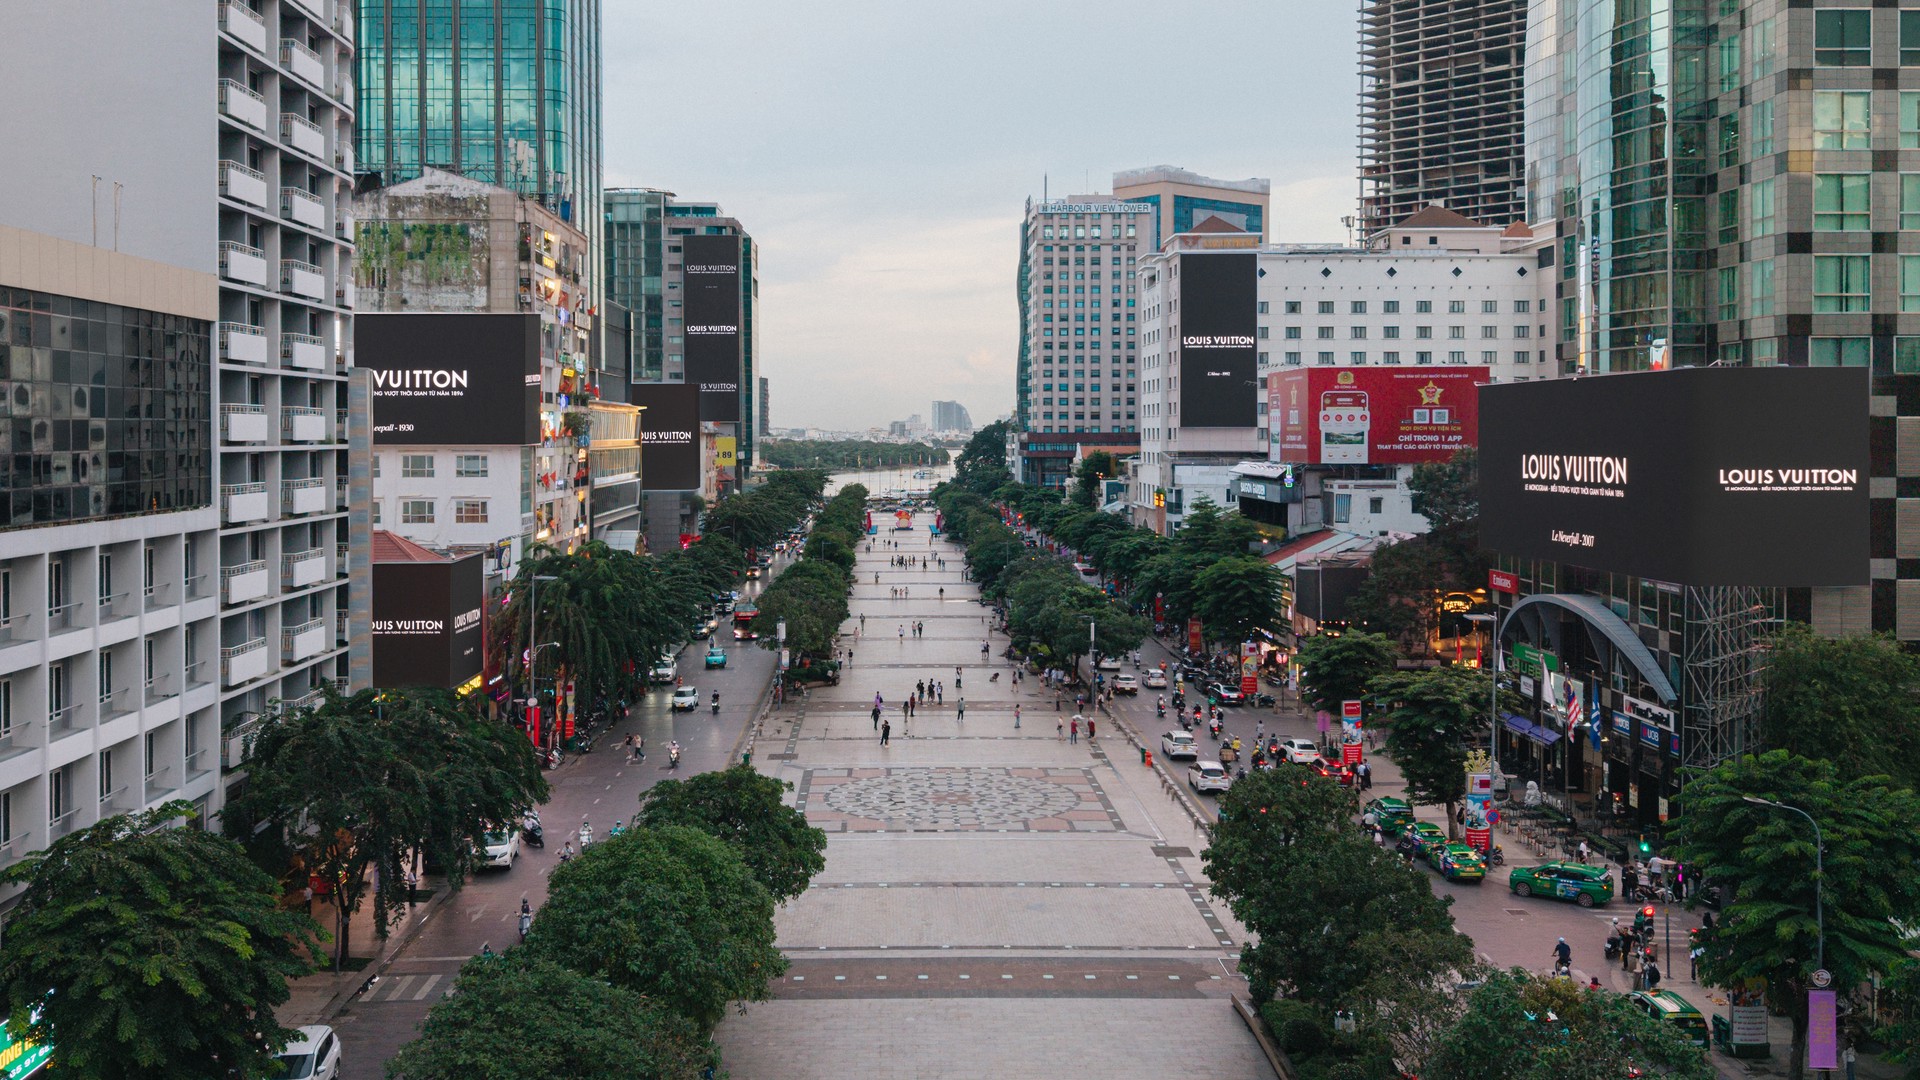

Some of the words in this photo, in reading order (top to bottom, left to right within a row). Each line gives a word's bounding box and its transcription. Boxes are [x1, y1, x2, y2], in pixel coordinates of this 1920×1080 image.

[1183, 336, 1212, 344] LOUIS
[1214, 336, 1254, 344] VUITTON
[373, 370, 467, 388] VUITTON
[374, 424, 394, 433] eepall
[659, 431, 691, 439] VUITTON
[1522, 454, 1560, 480] LOUIS
[1563, 456, 1627, 484] VUITTON
[1720, 469, 1774, 484] LOUIS
[1778, 469, 1857, 484] VUITTON
[1552, 530, 1558, 541] Le
[1582, 535, 1594, 547] 2007
[1493, 574, 1511, 588] Emirates
[396, 620, 443, 630] VUITTON
[454, 613, 466, 628] LOUIS
[466, 608, 480, 624] VUITTON
[1619, 718, 1629, 730] UOB
[1647, 729, 1658, 741] UOB
[24, 1053, 36, 1067] 97
